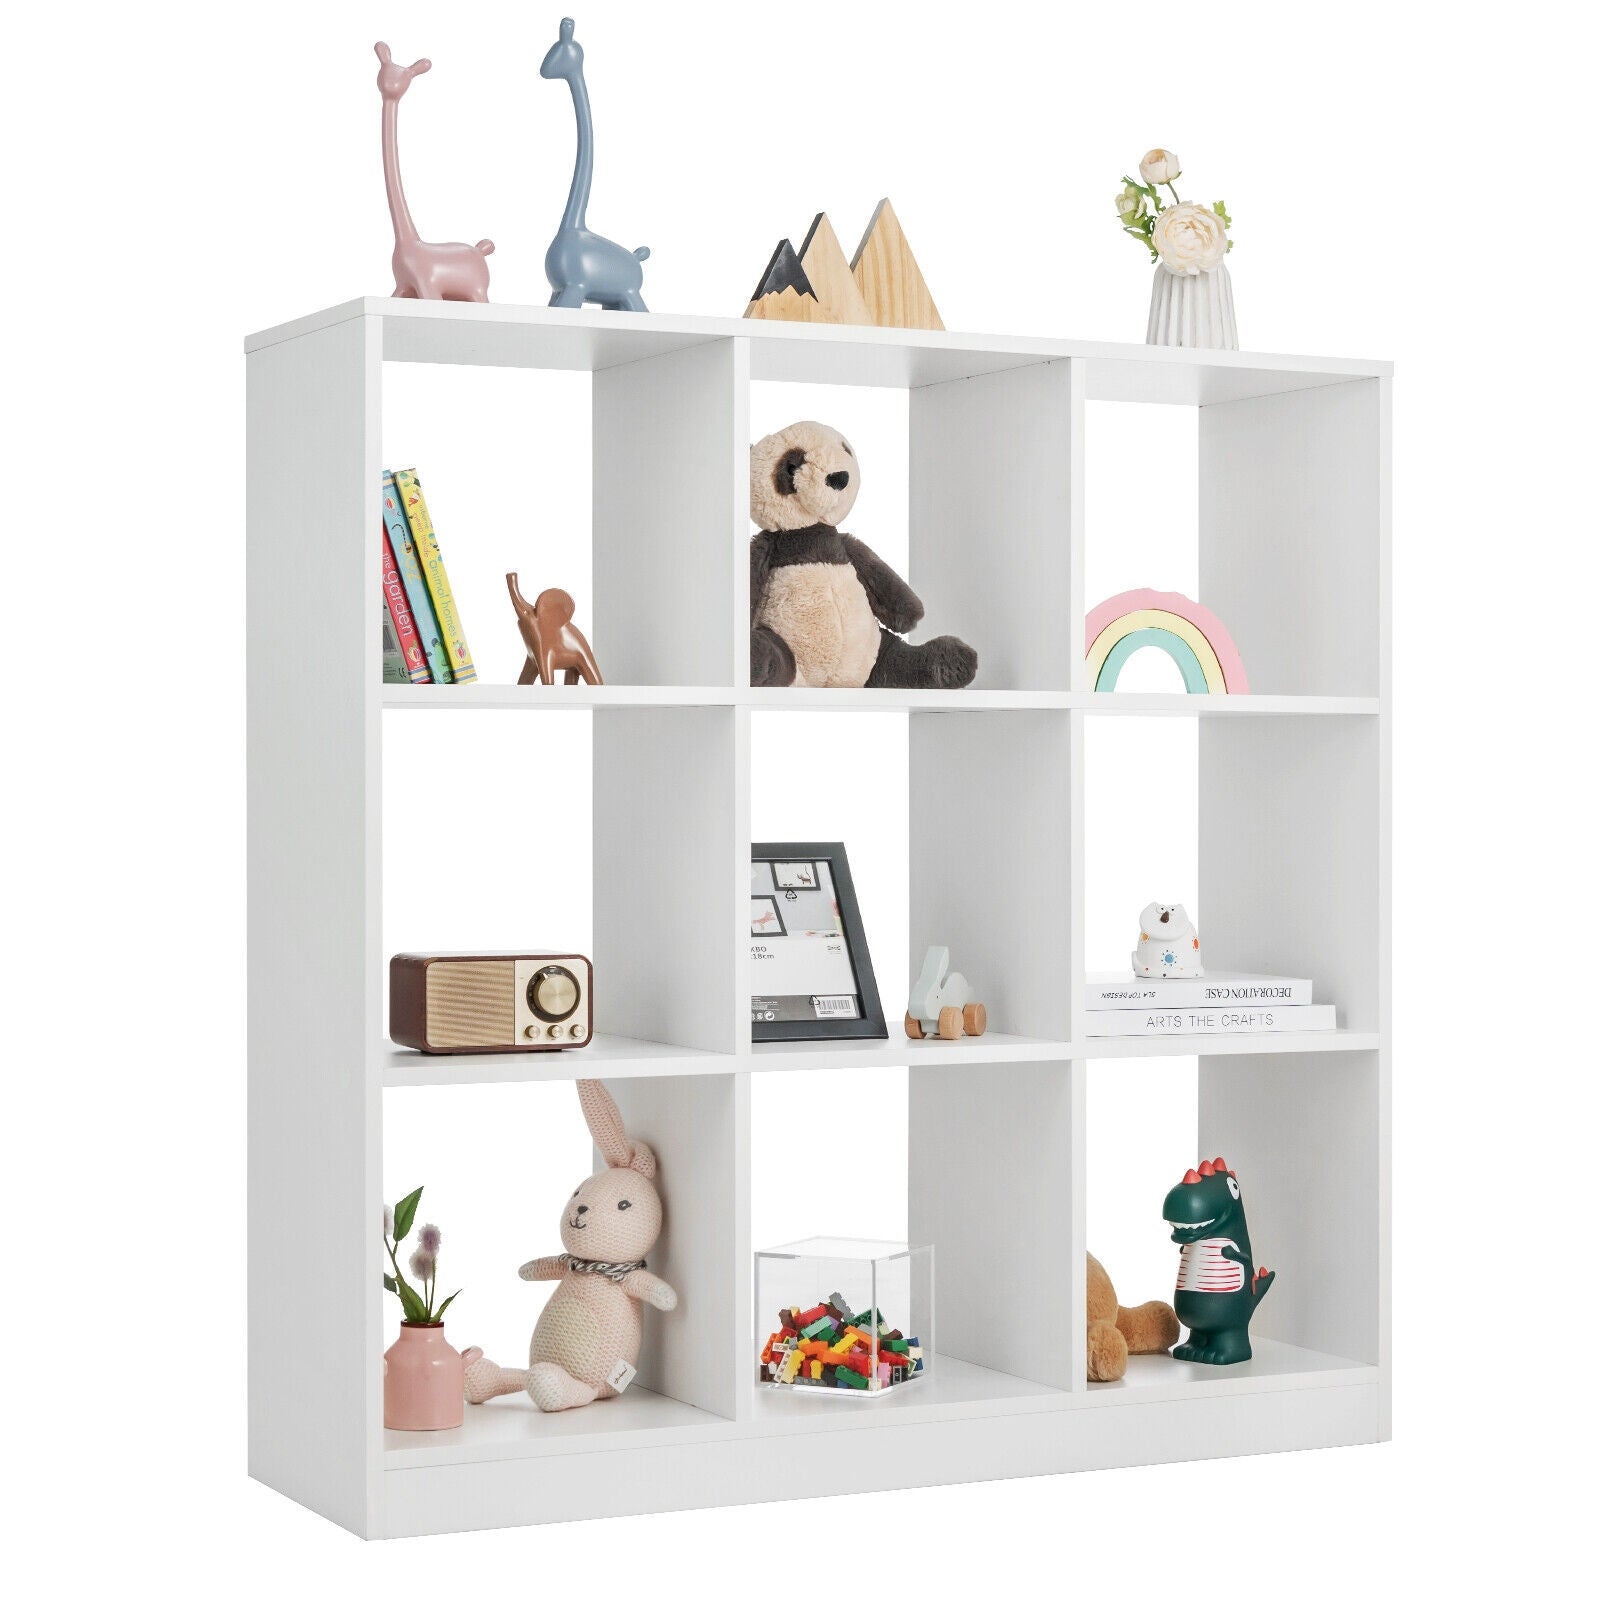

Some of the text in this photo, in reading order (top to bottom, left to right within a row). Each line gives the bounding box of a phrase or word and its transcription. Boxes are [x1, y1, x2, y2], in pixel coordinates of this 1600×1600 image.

[383, 570, 413, 636] garden
[429, 559, 457, 637] animal homes
[1204, 987, 1292, 999] DECORATION CASE
[1146, 1013, 1274, 1028] ARTS THE CRAFTS
